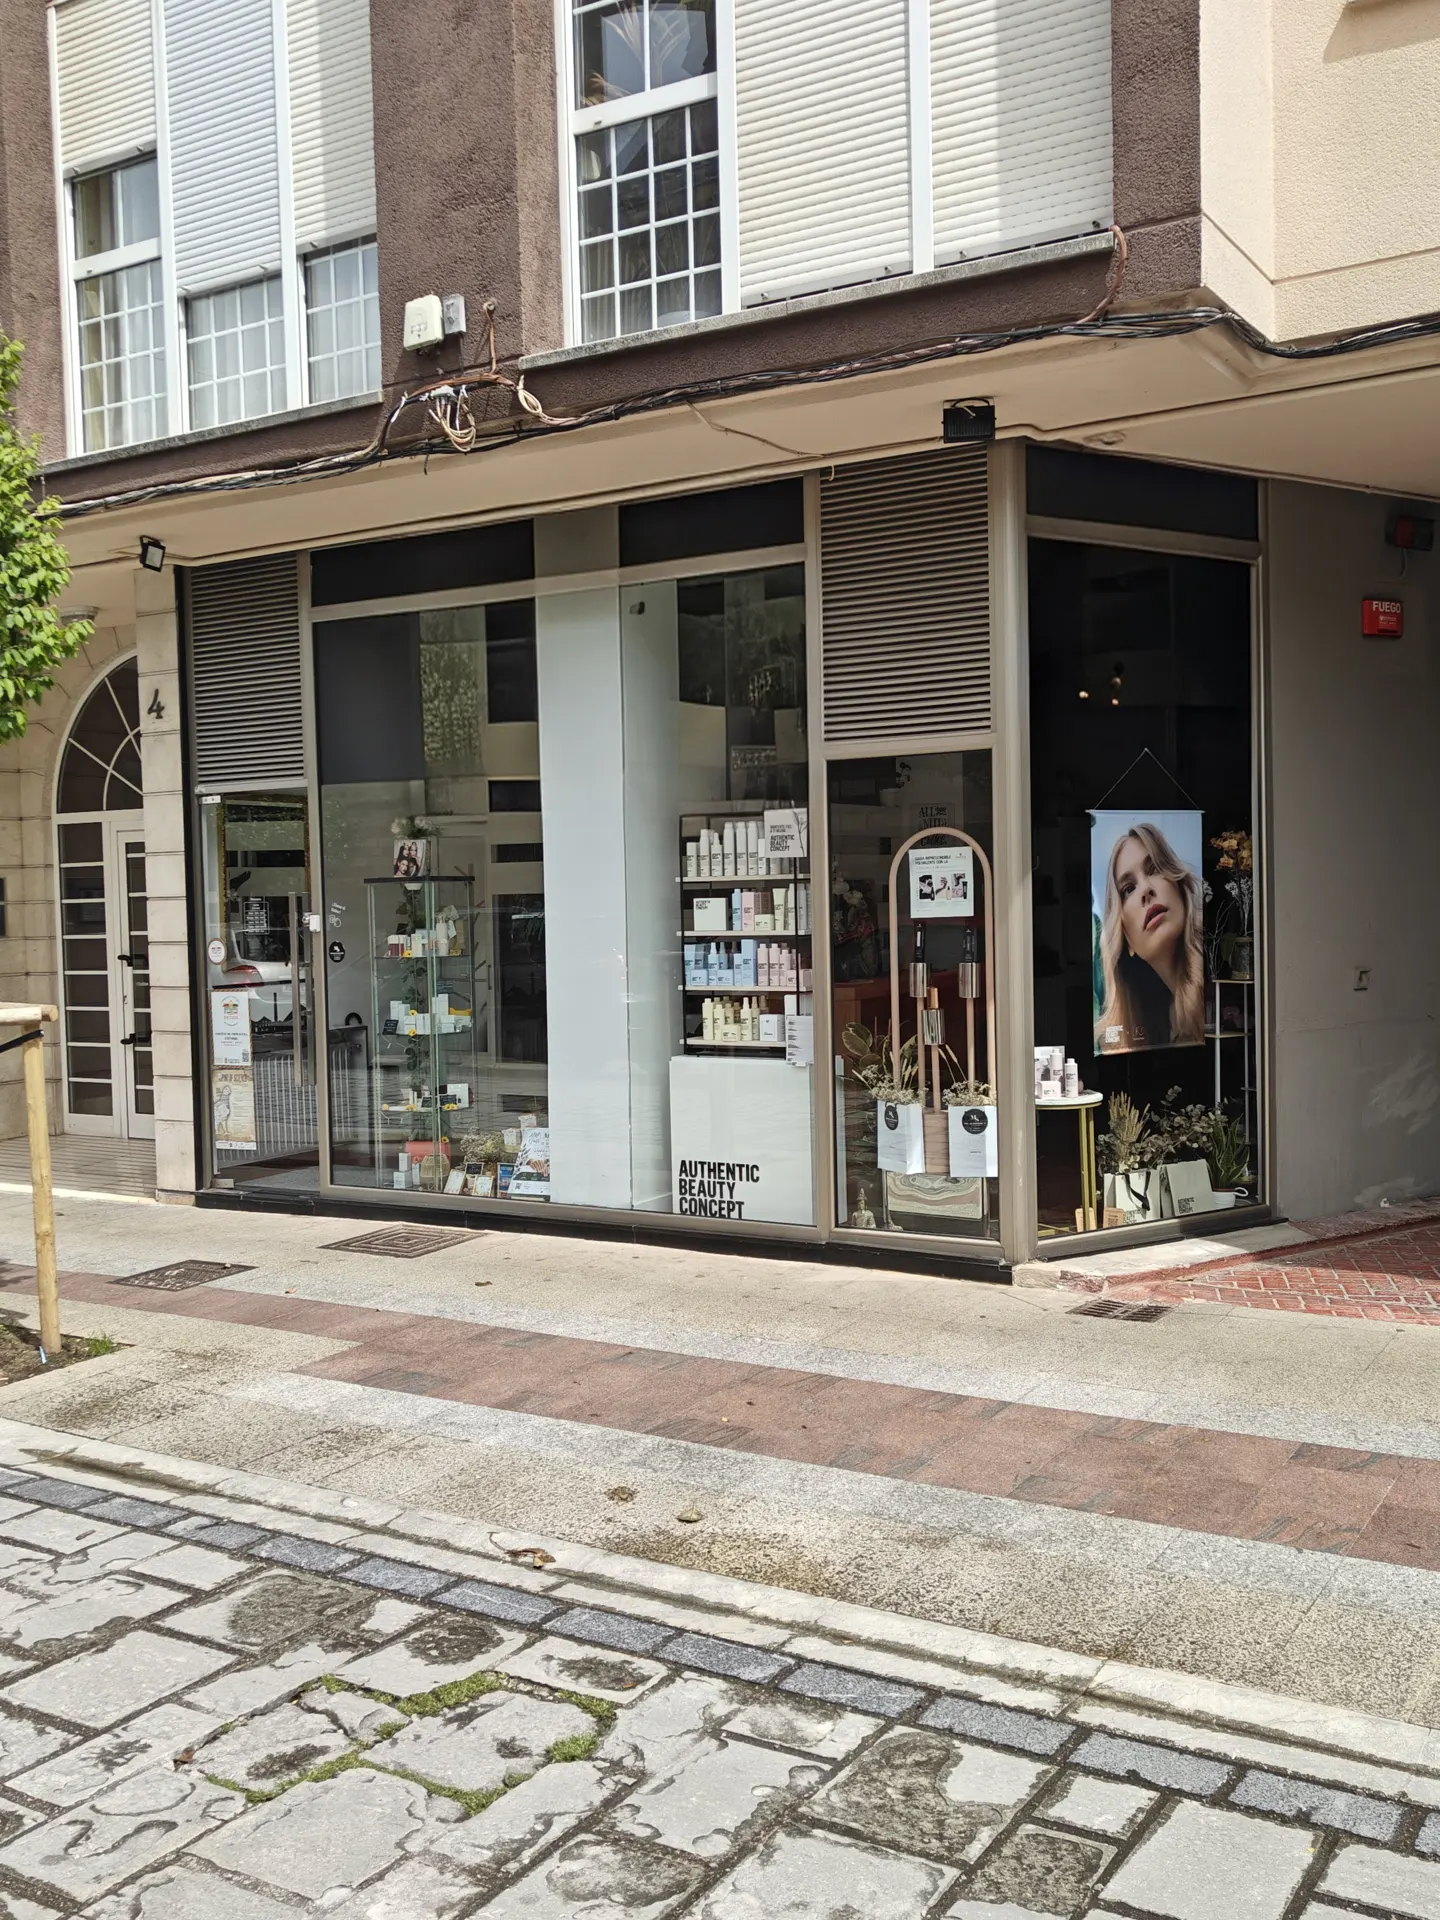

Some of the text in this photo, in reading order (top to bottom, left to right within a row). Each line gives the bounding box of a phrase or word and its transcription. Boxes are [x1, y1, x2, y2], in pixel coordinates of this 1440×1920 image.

[1372, 601, 1401, 613] FUEGO
[147, 688, 165, 720] 4
[679, 1160, 760, 1183] AUTHENTIC
[679, 1178, 736, 1200] BEAUTY
[679, 1196, 745, 1219] CONCEPT
